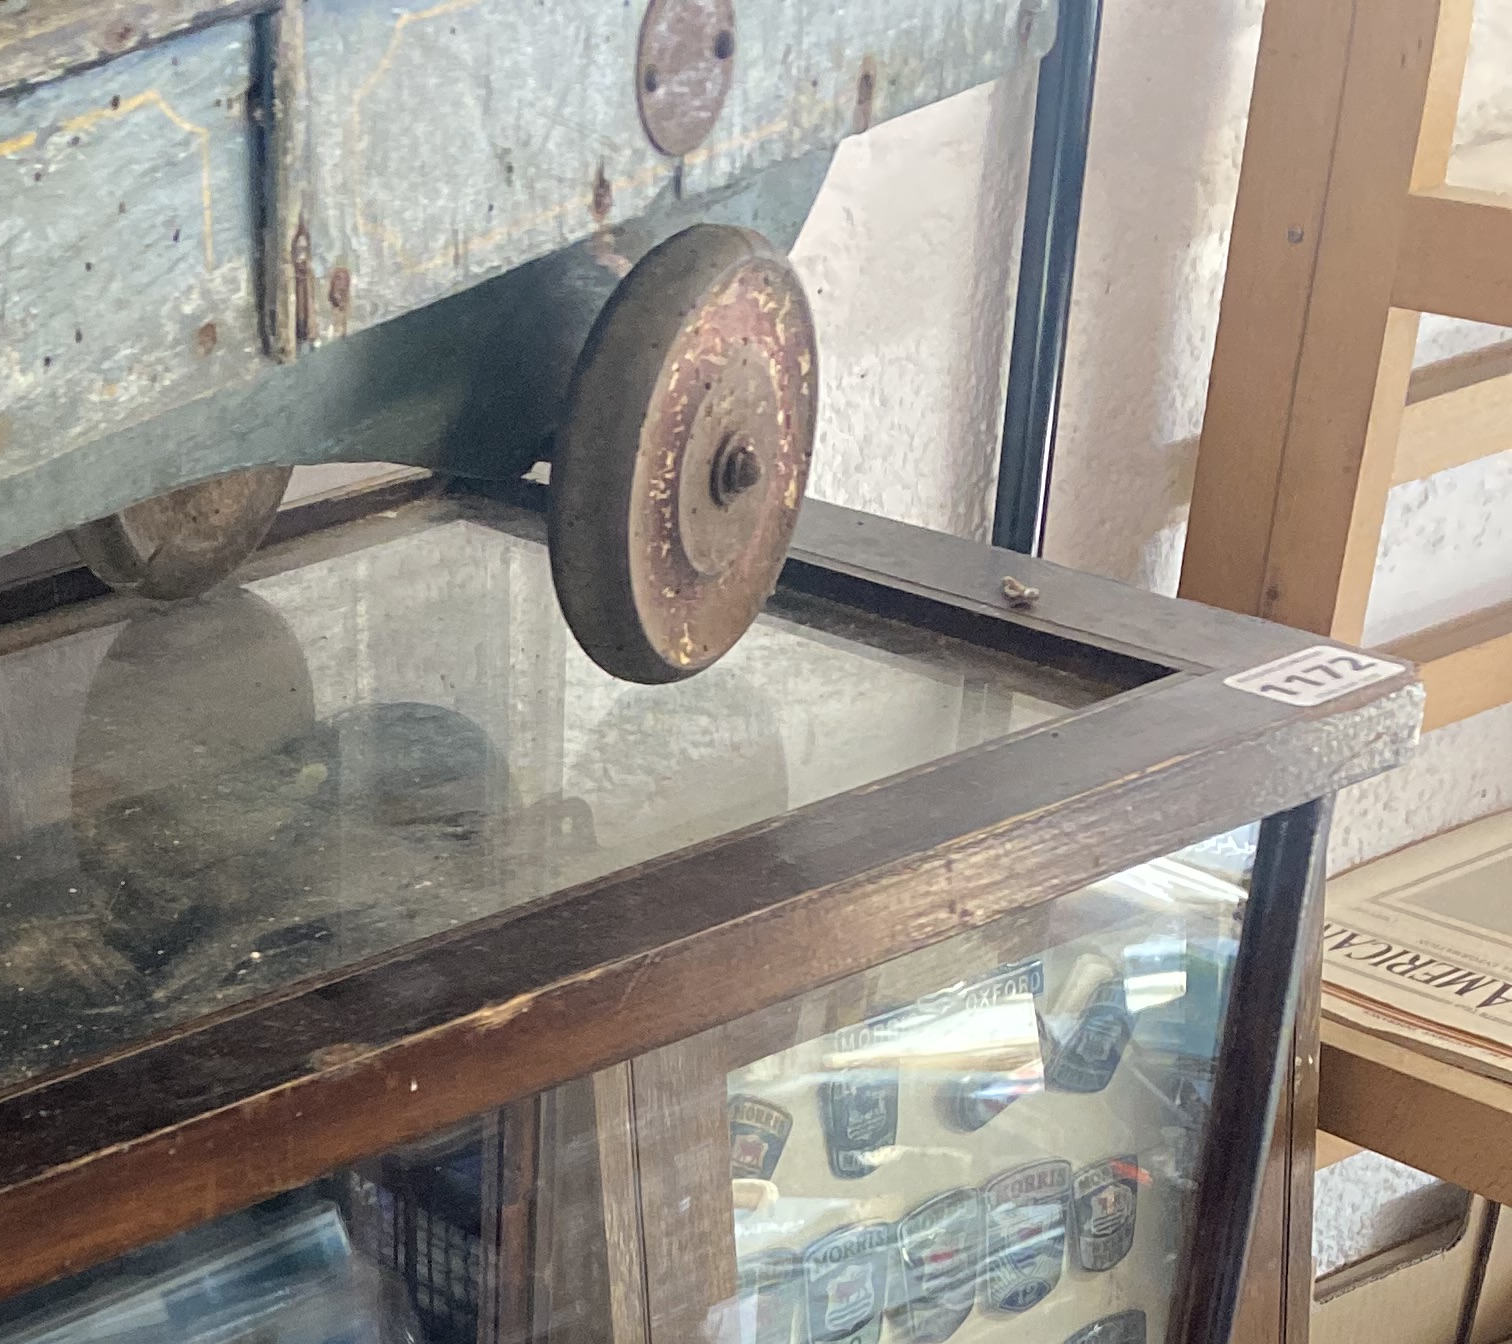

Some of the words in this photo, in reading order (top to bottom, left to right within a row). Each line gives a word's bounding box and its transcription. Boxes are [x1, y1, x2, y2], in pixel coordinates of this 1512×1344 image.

[1261, 656, 1376, 696] 1172
[965, 970, 1041, 1010] OXFORD
[813, 1230, 886, 1271] MORRIS
